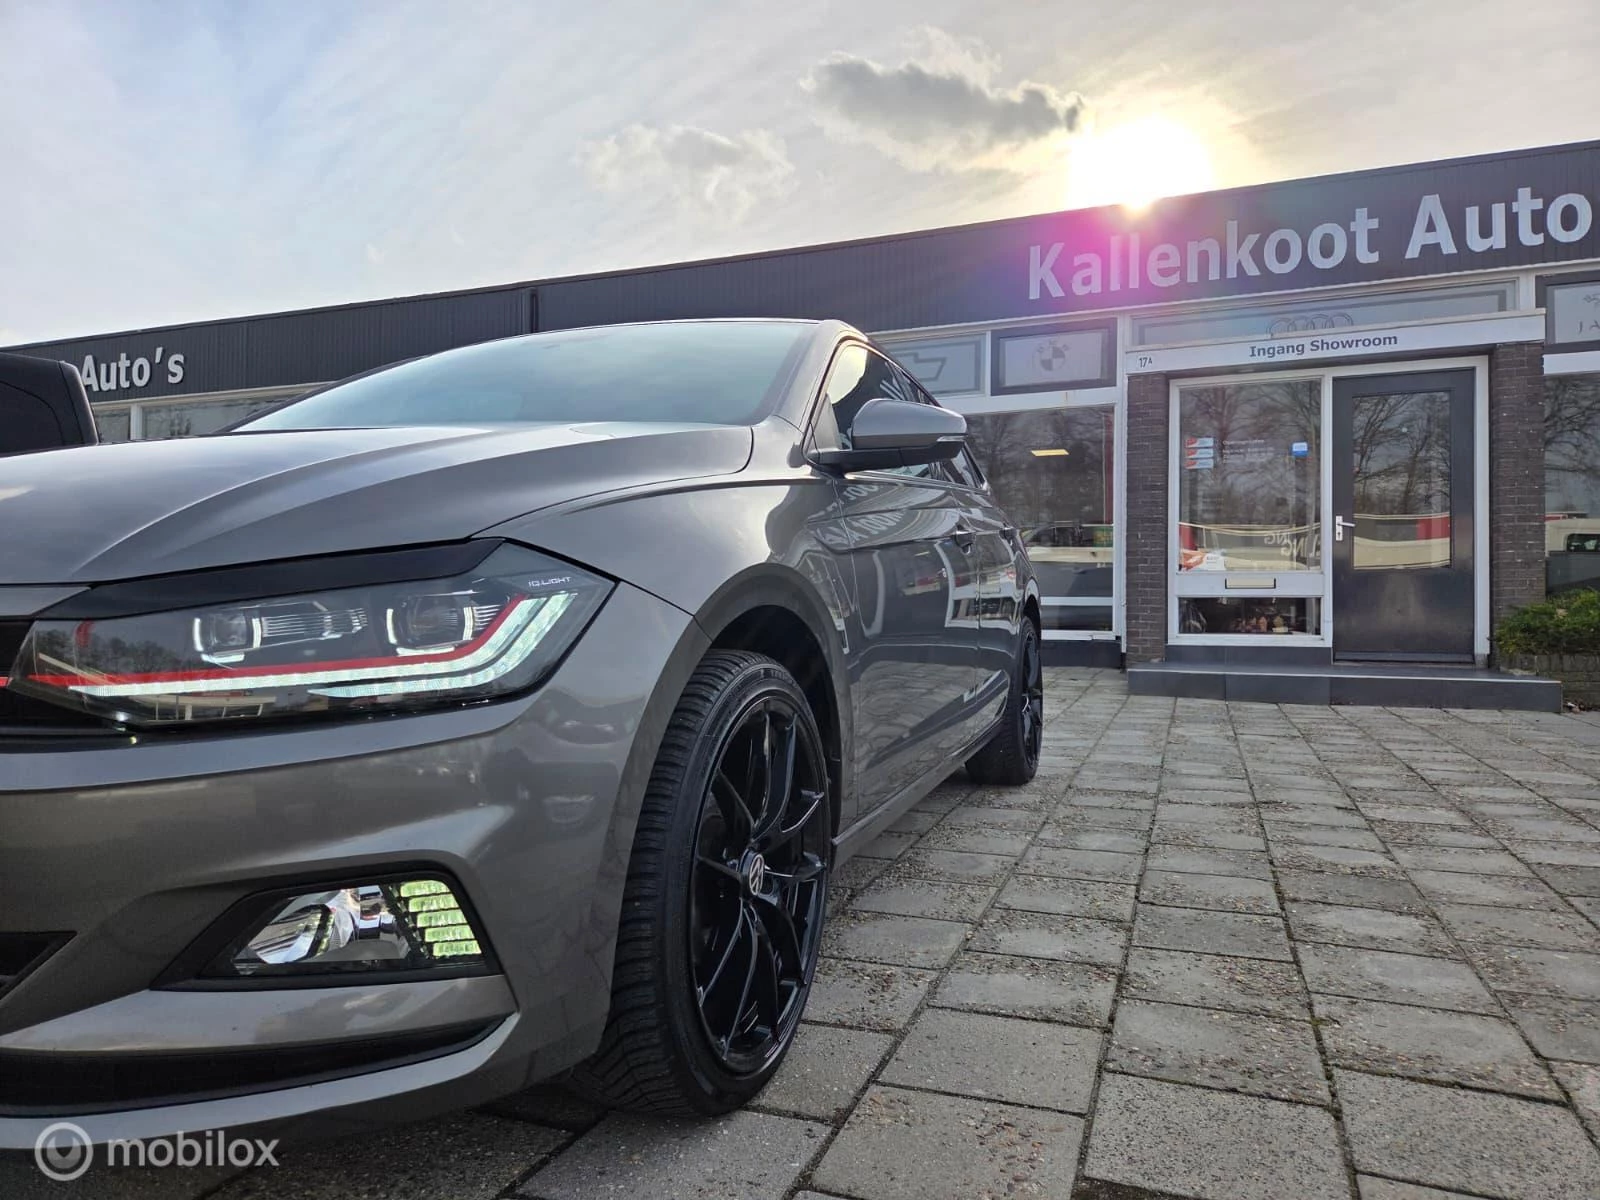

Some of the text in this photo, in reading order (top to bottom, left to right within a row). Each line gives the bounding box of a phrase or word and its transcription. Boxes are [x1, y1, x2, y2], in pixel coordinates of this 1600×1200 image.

[1028, 186, 1593, 300] Kallenkoot Auto
[81, 346, 185, 392] Auto's
[1250, 335, 1398, 358] Ingang Showroom
